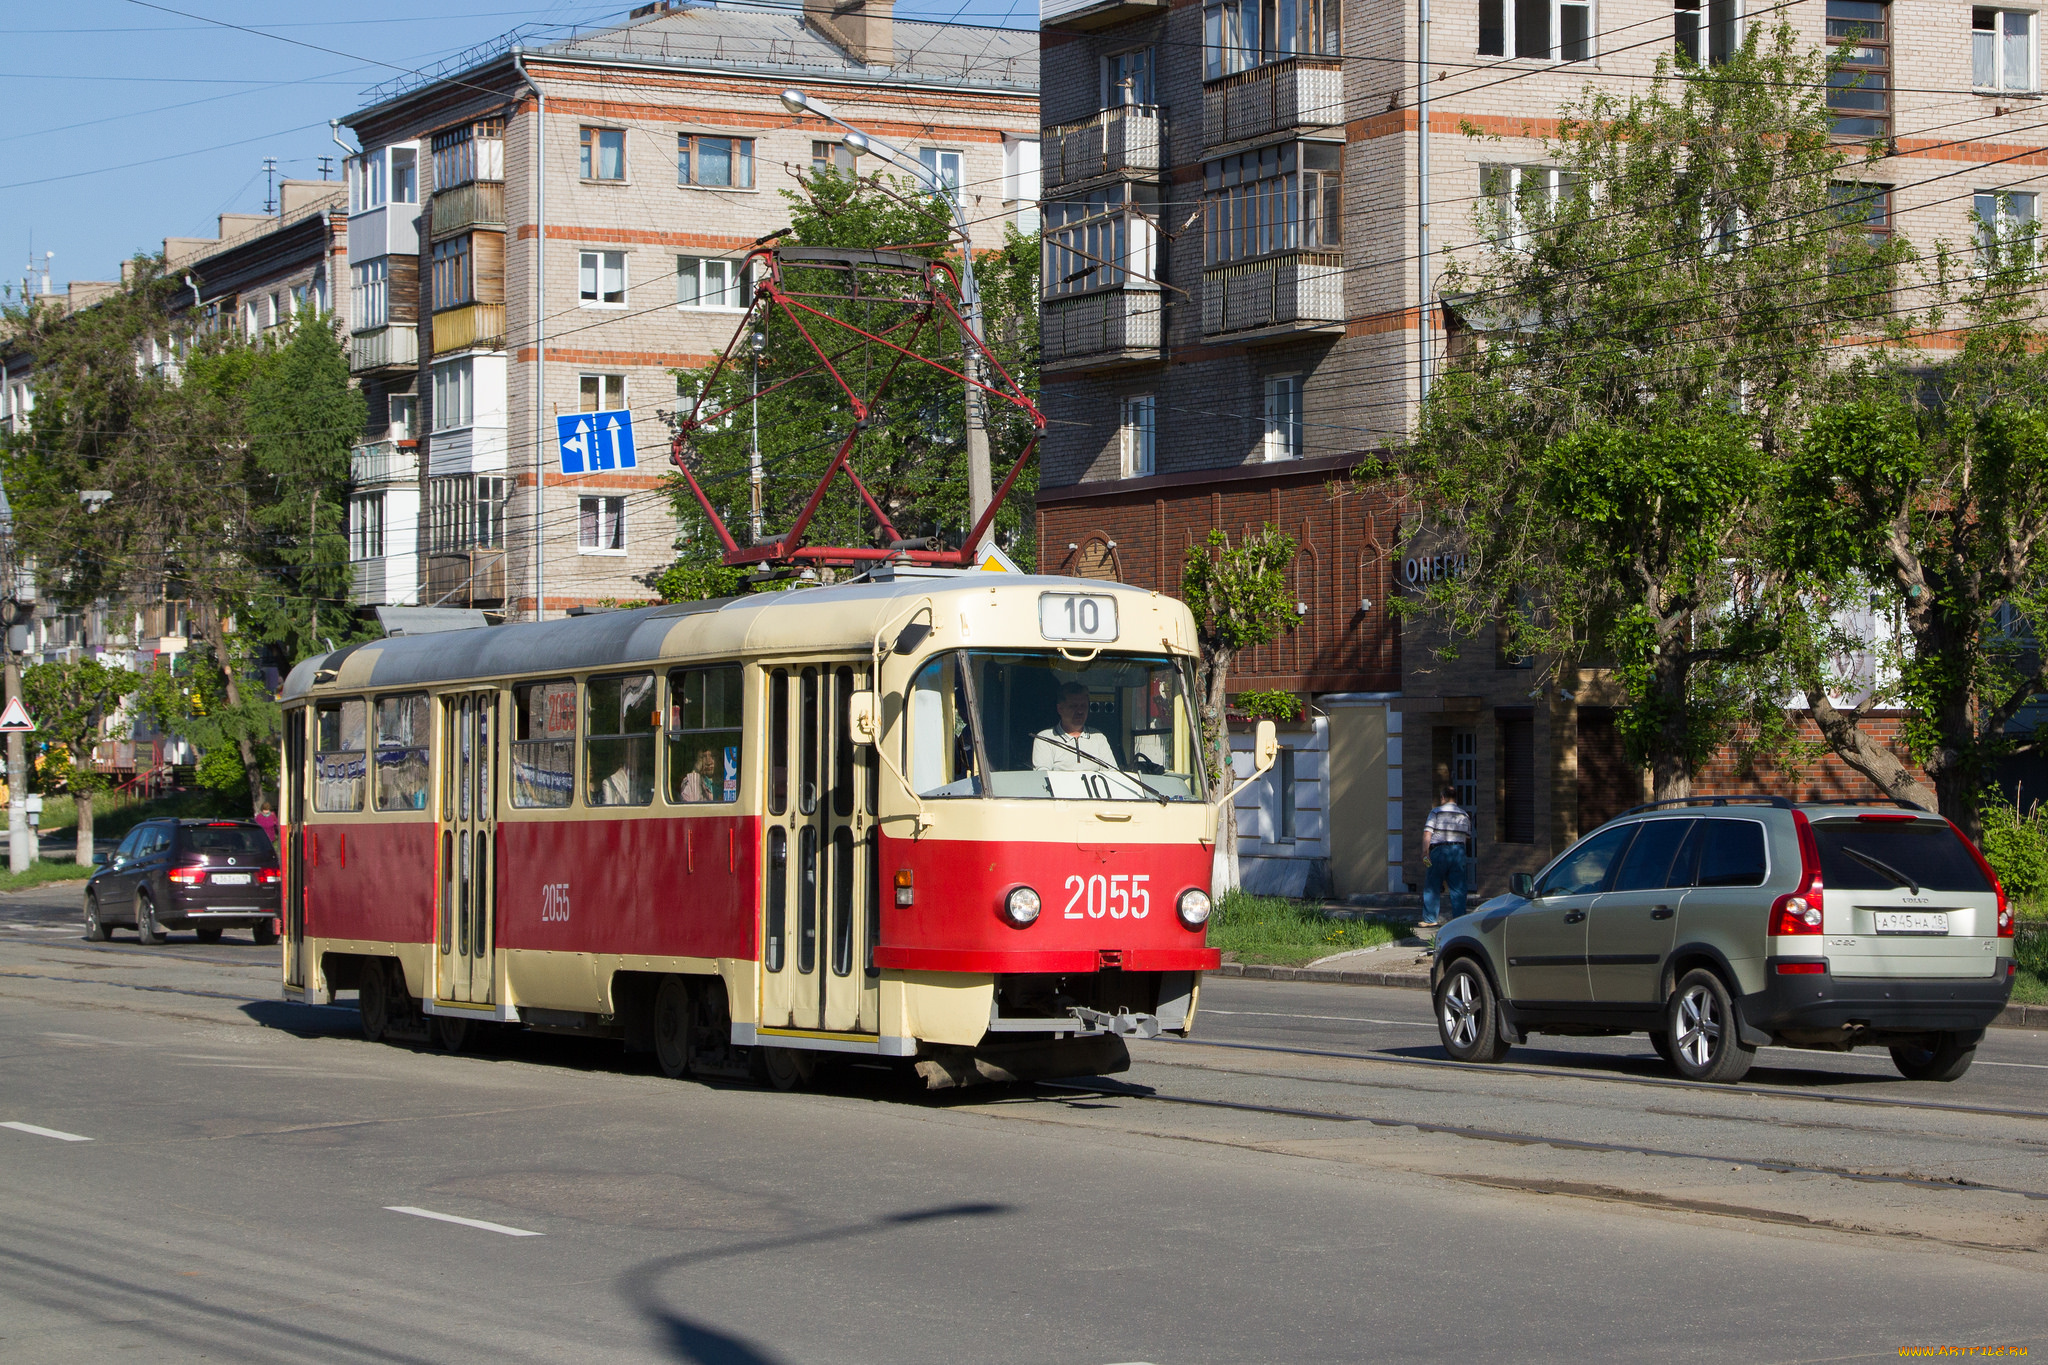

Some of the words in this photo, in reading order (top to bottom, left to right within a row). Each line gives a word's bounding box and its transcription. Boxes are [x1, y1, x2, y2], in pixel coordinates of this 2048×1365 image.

[1064, 597, 1099, 634] 10
[549, 692, 576, 732] 2055
[1081, 773, 1112, 798] 10
[542, 883, 570, 921] 2055
[1064, 874, 1150, 919] 2055
